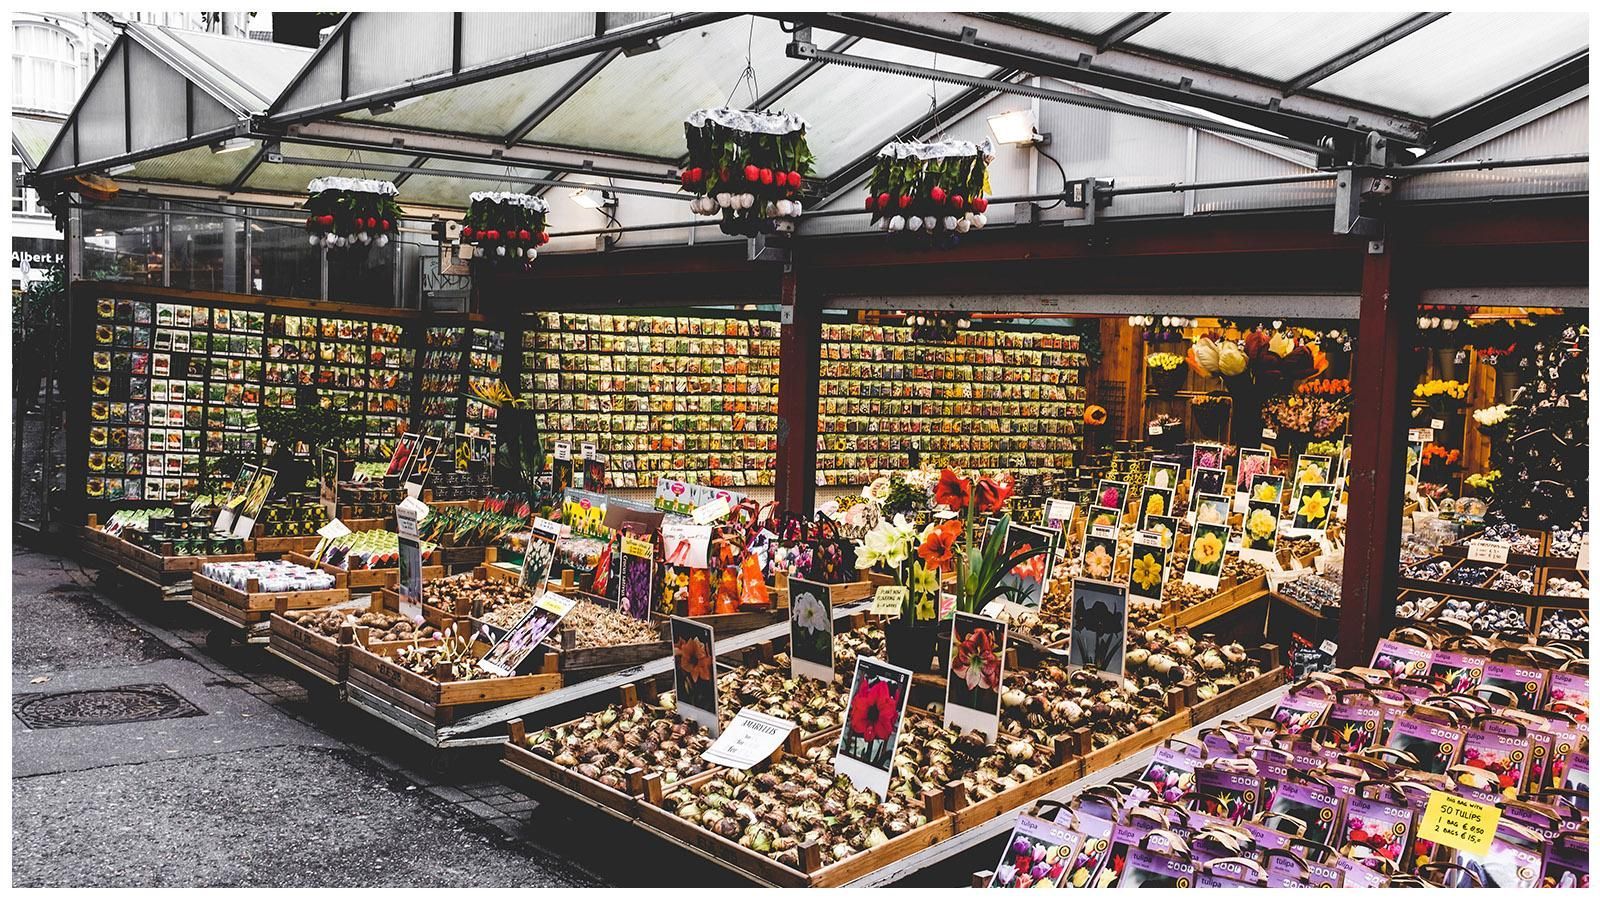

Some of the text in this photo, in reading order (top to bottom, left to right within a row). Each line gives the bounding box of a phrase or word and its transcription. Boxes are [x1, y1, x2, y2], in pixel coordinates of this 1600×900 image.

[12, 251, 64, 264] Albert H
[1488, 665, 1504, 674] tulipa
[1554, 674, 1572, 683] tulipa
[1400, 722, 1418, 731] tulipa
[1488, 725, 1507, 734] tulipa
[1282, 785, 1298, 795] tulipa
[1352, 801, 1370, 810] tulipa
[1441, 804, 1482, 822] 50 TULIPS
[1511, 808, 1532, 820] tulipa
[1021, 819, 1038, 830] tulipa
[1118, 828, 1135, 838] tulipa
[1133, 852, 1152, 864] tulipa
[1276, 857, 1294, 868] tulipa
[1201, 877, 1222, 888] tulipa
